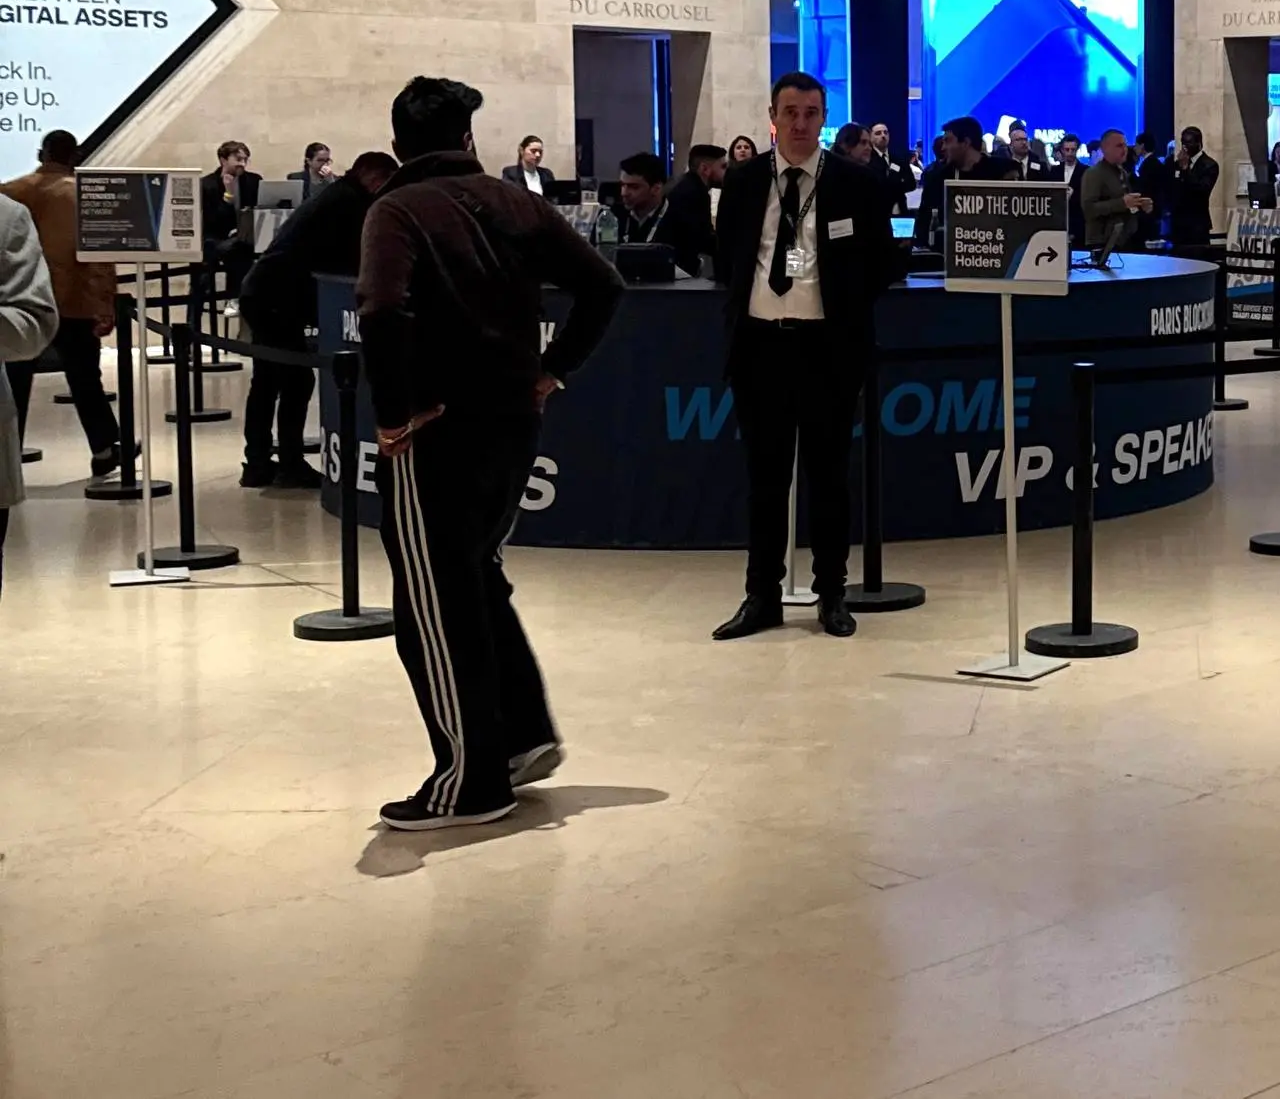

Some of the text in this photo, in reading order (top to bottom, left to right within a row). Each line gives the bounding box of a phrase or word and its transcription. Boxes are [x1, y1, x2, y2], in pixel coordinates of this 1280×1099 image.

[0, 5, 168, 29] GITAL ASSETS
[605, 0, 716, 22] CARROUSEL
[1222, 13, 1243, 27] DU
[0, 61, 52, 80] ck In.
[24, 87, 60, 110] Up.
[19, 113, 42, 132] In.
[955, 195, 1052, 217] SKIP THE QUEUE
[955, 227, 1005, 242] Badge &
[955, 241, 1004, 254] Bracelet
[955, 255, 1001, 268] Holders
[1151, 305, 1181, 336] PARIS
